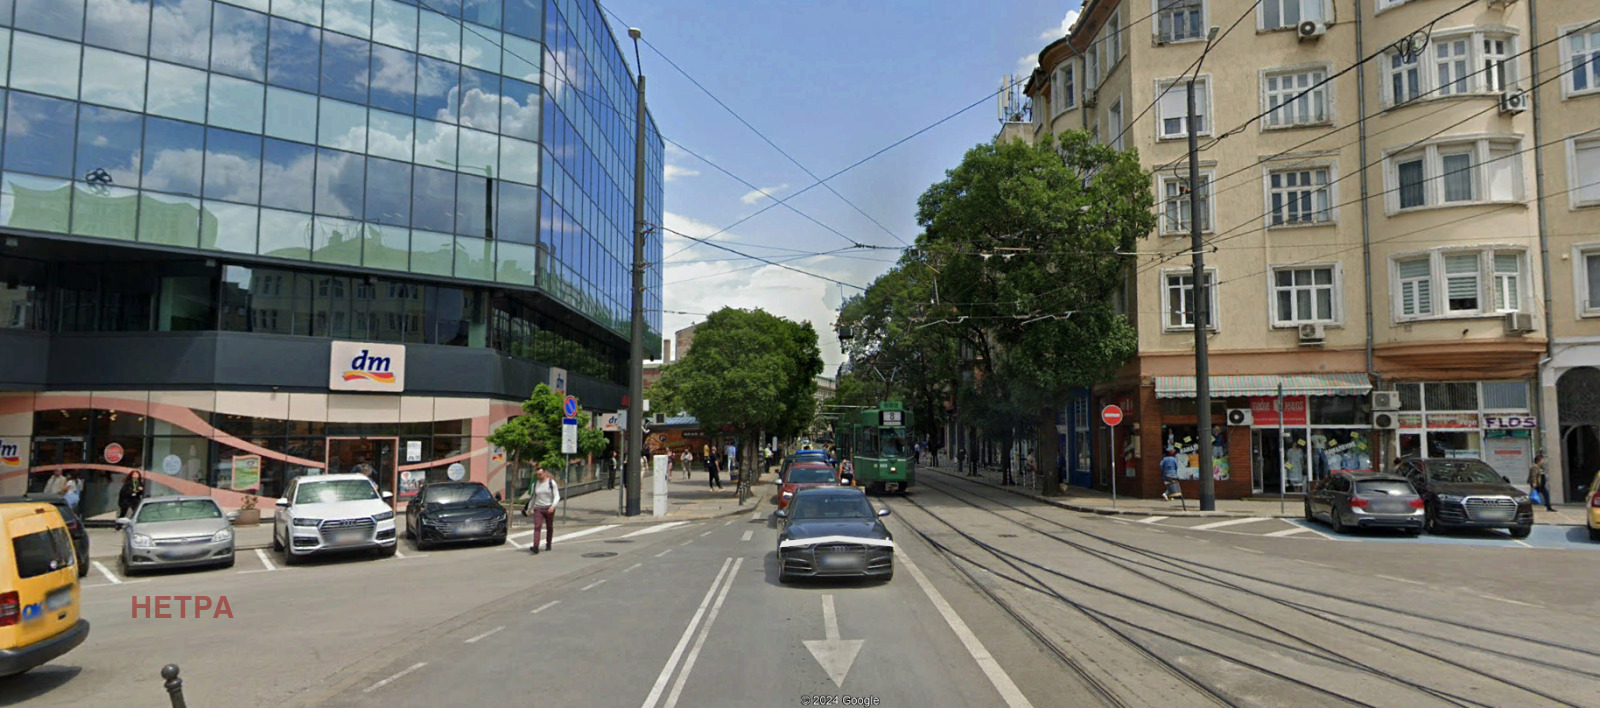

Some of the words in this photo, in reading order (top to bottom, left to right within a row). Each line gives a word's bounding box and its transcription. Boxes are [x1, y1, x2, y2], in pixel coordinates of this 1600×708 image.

[351, 350, 391, 372] dm
[889, 412, 895, 420] 8
[1485, 417, 1535, 428] FLOS
